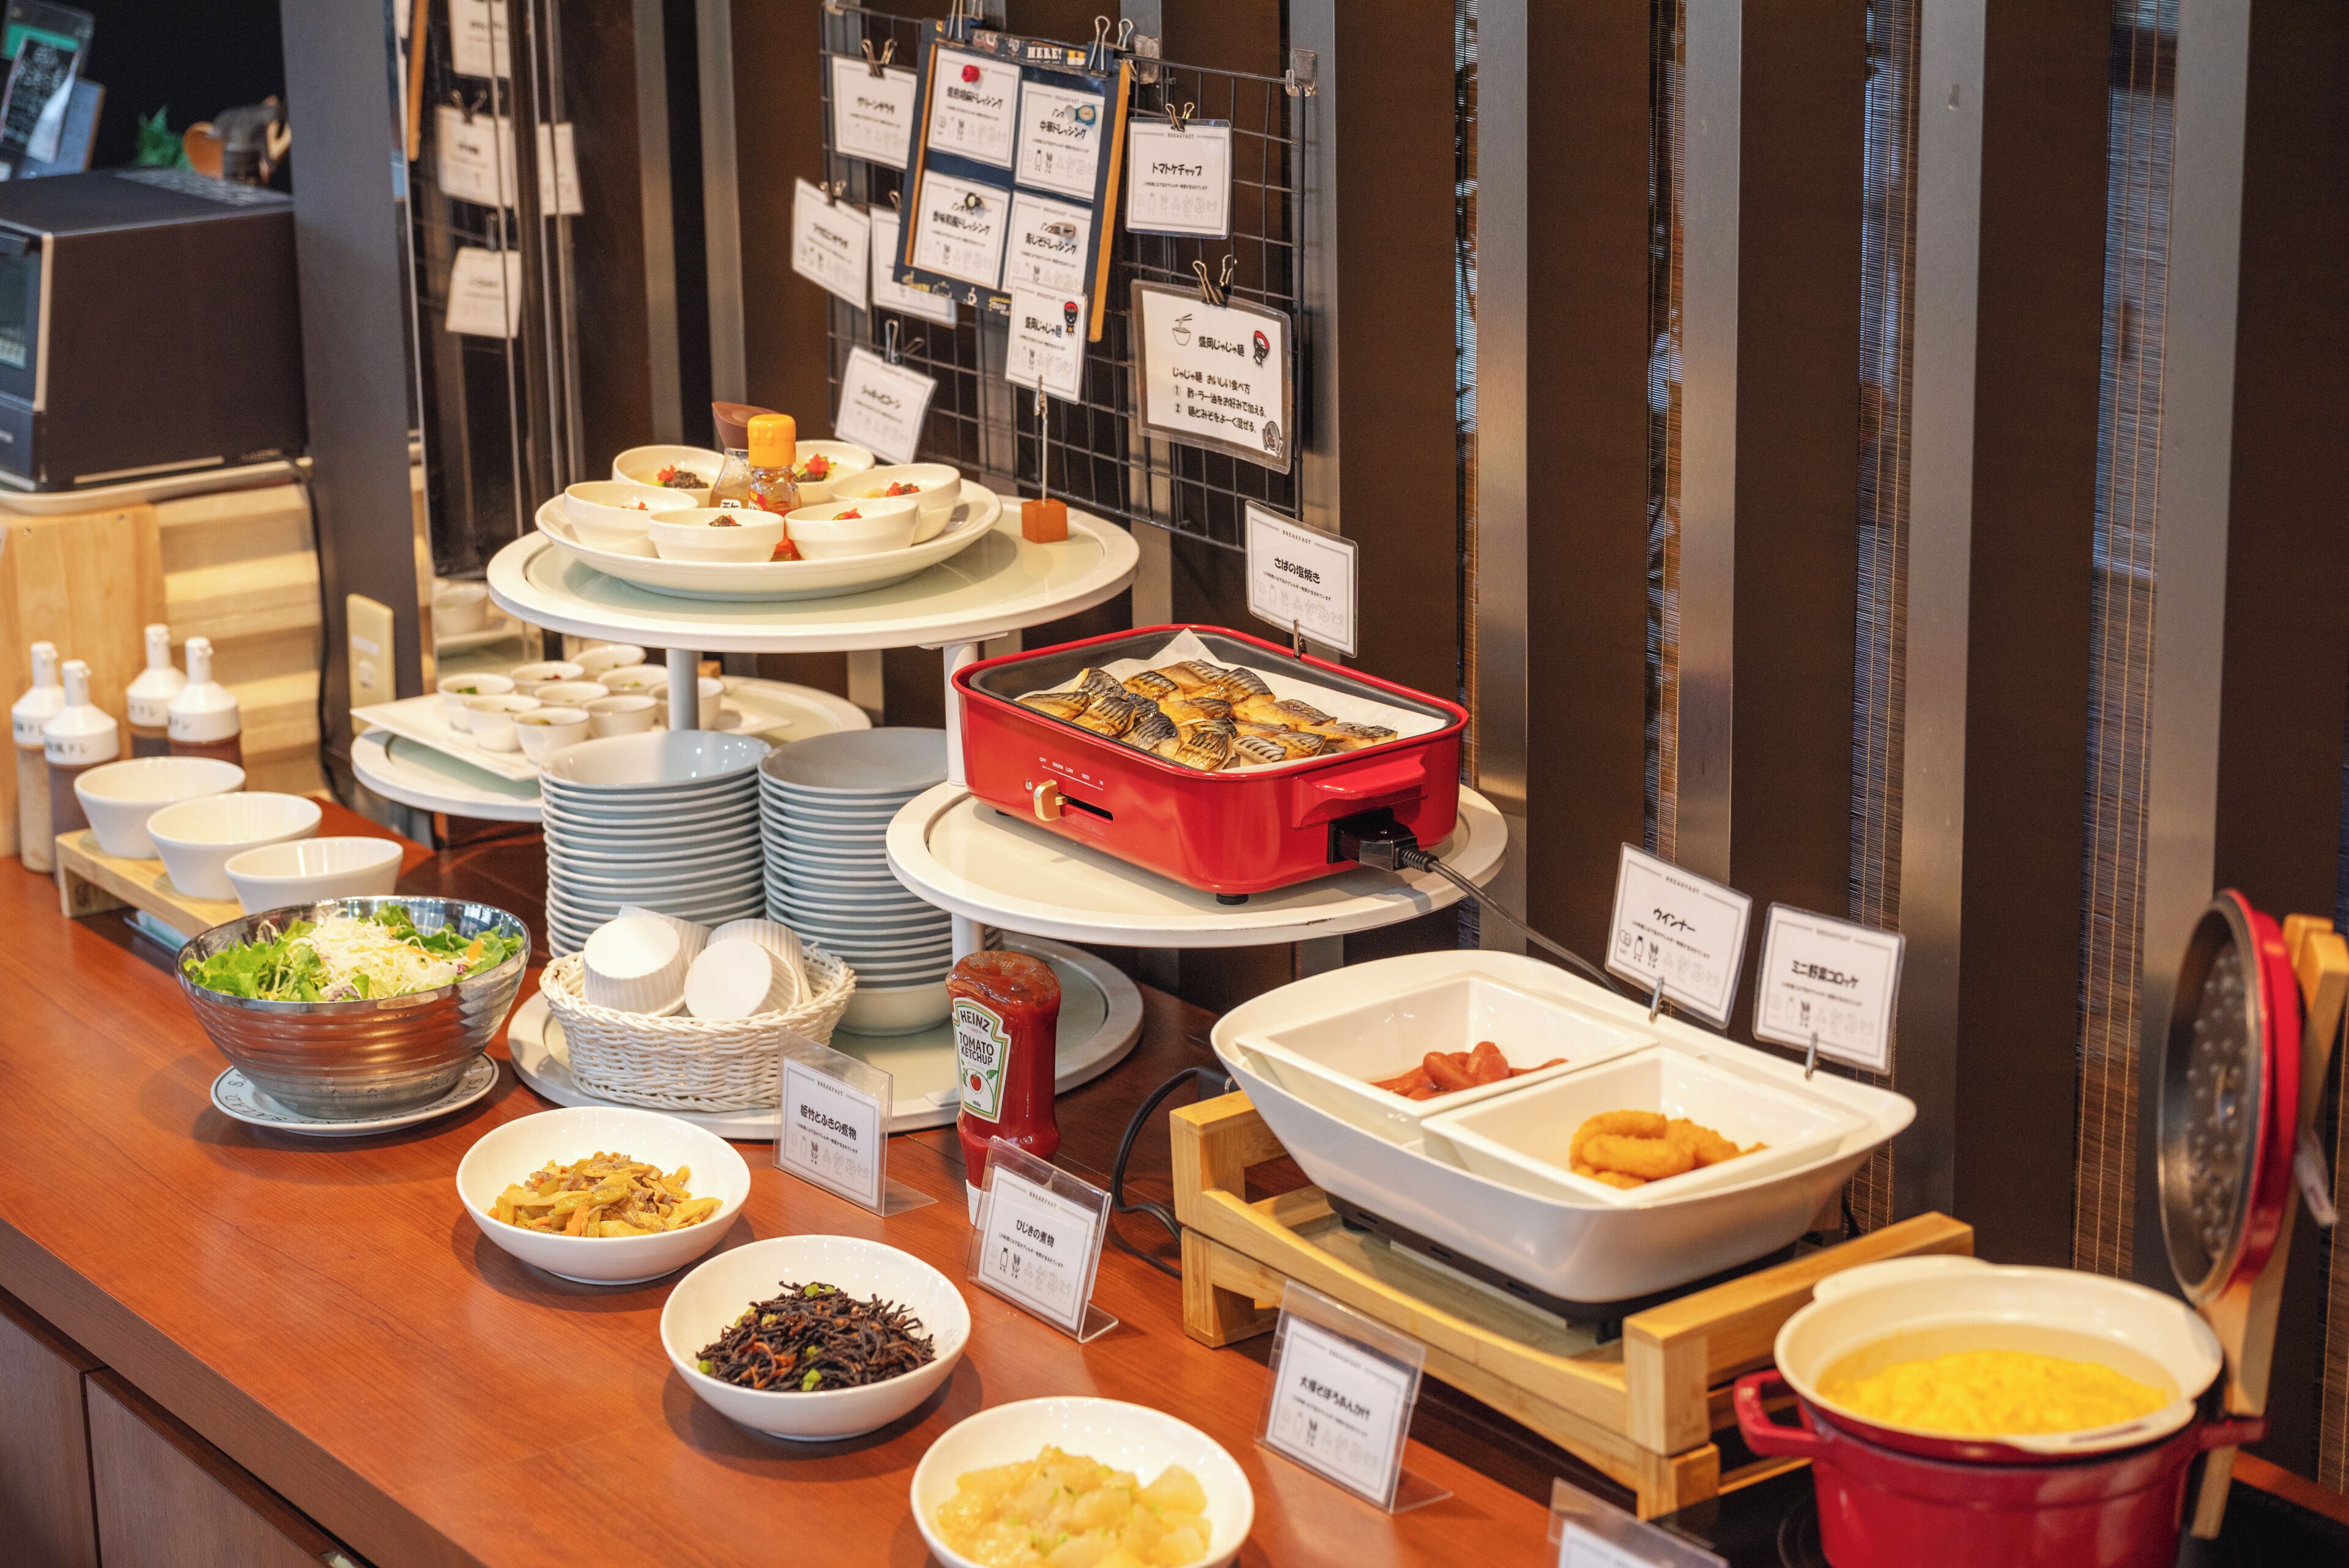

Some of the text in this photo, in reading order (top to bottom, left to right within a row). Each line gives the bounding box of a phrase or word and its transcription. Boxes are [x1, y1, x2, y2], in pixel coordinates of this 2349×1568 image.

[1026, 46, 1062, 60] HERE!
[1040, 119, 1086, 139] 中華ドレッシング
[1152, 162, 1203, 177] トマトケチャップ
[1025, 232, 1077, 255] 青じそドレッシング
[1025, 316, 1062, 338] 盛岡じゃじゃ麺
[1198, 336, 1245, 357] 盛岡じゃじゃ麺
[1172, 367, 1250, 395] じゃじゃ麺 おいしい食べ方
[1282, 530, 1312, 544] BREAKFAST
[1274, 557, 1321, 584] さばの塩焼き
[1666, 877, 1699, 894] BREAKFAST
[1653, 908, 1696, 931] ウインナー
[1792, 960, 1858, 989] ミニ野菜コロッケ
[960, 1010, 990, 1033] HEINZ
[959, 1031, 994, 1056] TOMATO
[961, 1045, 992, 1065] KETCHUP
[817, 1080, 843, 1096] BREAKFAST
[801, 1104, 856, 1141] 姫竹とふきの煮物
[1030, 1192, 1057, 1209] BREAKFAST
[1016, 1219, 1055, 1247] ひじきの煮物
